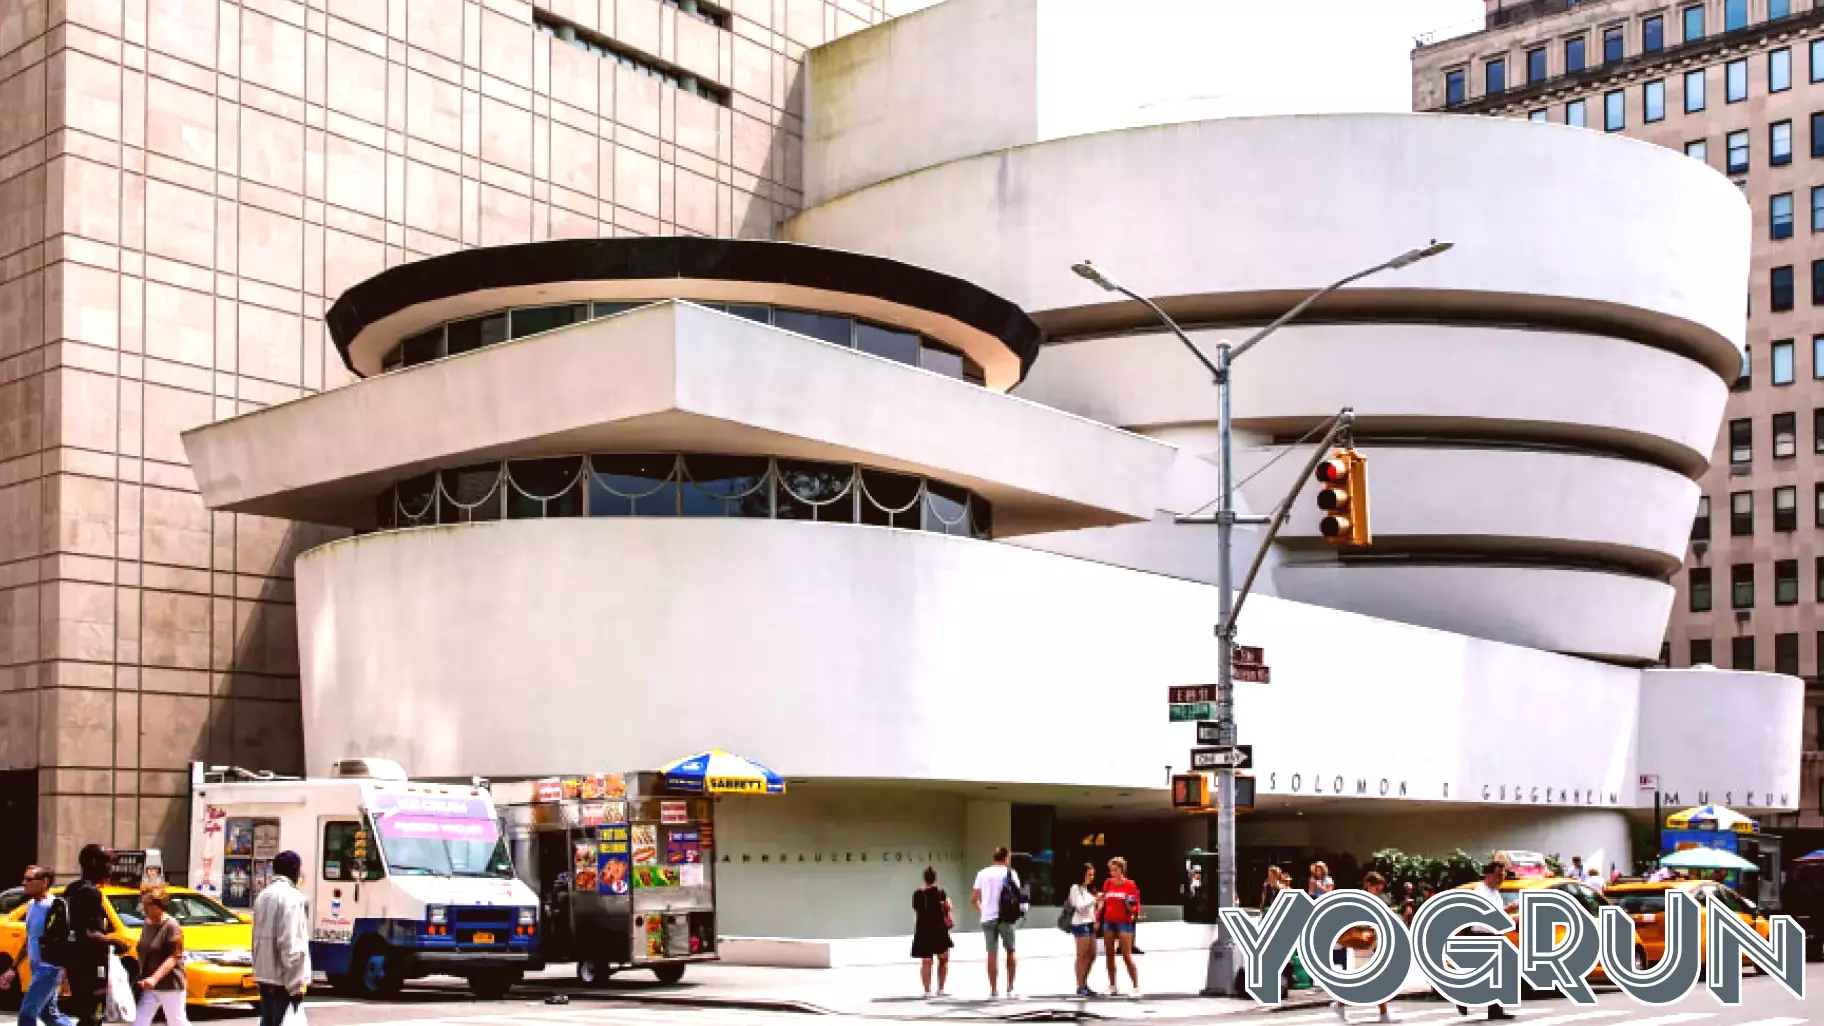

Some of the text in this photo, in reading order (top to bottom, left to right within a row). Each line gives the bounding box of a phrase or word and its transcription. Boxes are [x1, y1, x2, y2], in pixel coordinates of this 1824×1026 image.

[1270, 772, 1407, 797] SOLOMON
[1483, 784, 1617, 805] GUGGENHEIM
[1664, 790, 1789, 806] MUSEUM
